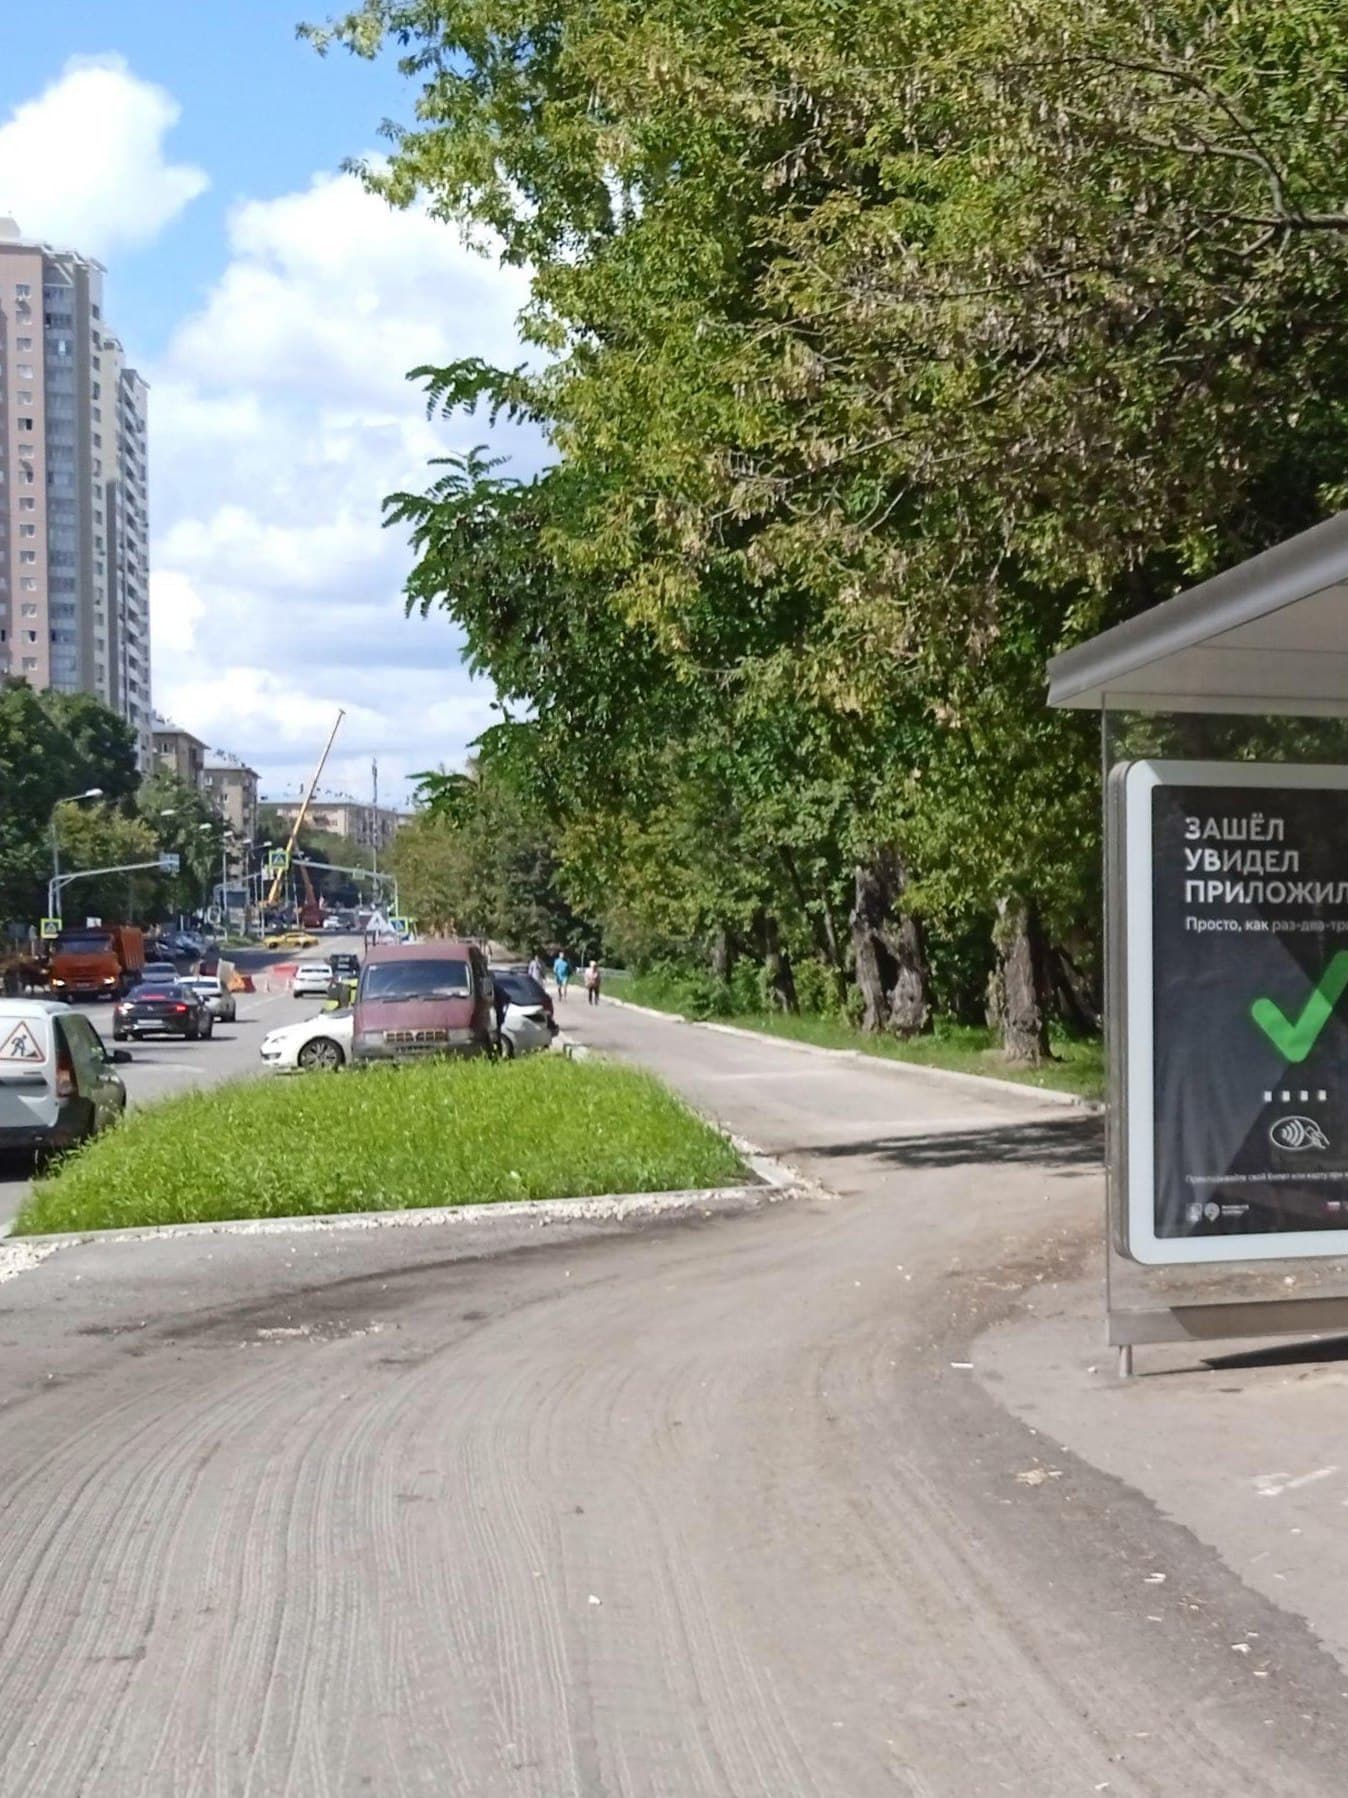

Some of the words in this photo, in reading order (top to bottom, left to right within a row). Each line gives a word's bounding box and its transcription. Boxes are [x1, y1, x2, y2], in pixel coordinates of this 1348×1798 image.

[1184, 812, 1285, 841] ЗАШЁЛ
[1184, 848, 1299, 876] УВИДЕЛ
[1186, 916, 1242, 933] Просто,
[1245, 920, 1269, 931] как
